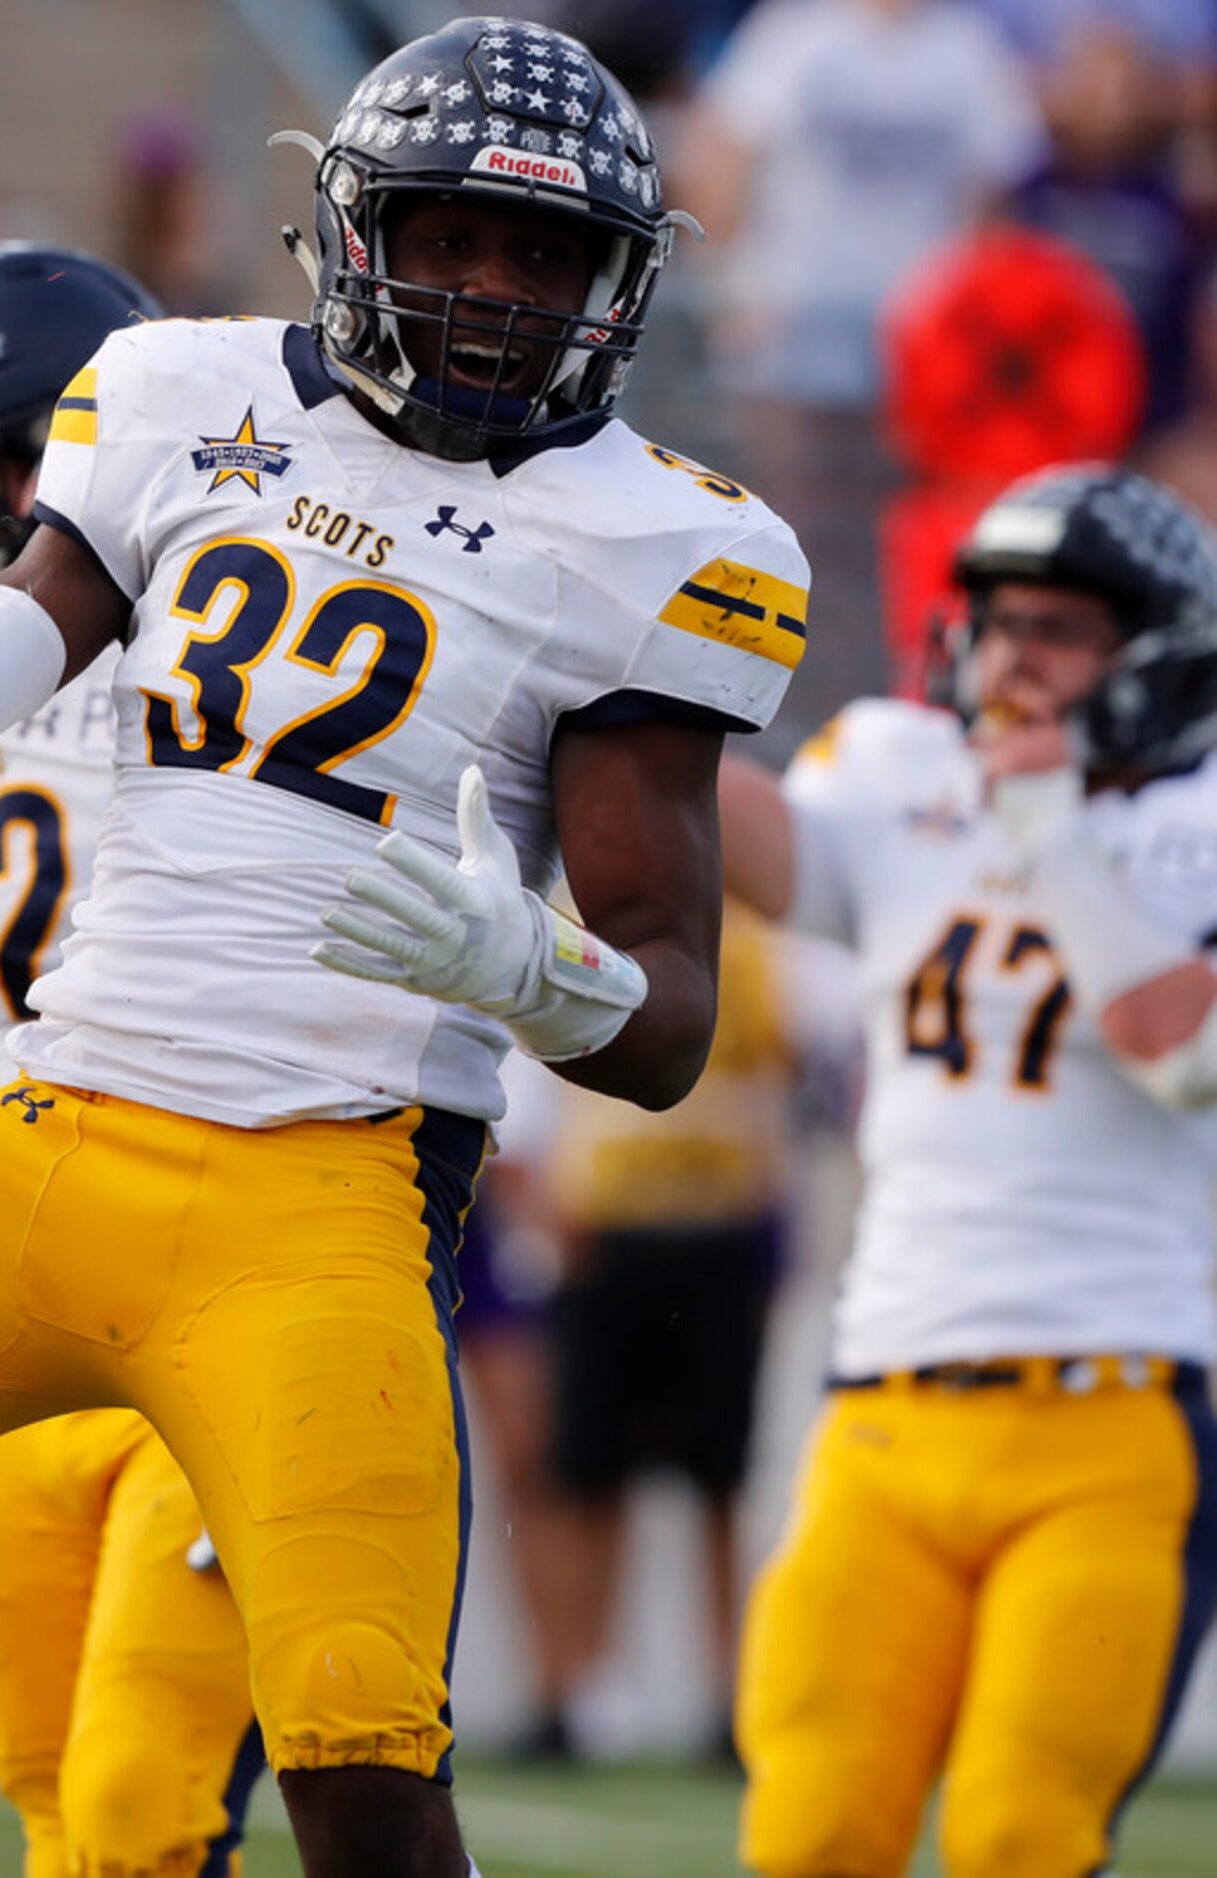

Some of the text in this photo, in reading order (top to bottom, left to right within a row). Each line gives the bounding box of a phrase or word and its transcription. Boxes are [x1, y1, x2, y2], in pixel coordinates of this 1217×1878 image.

[286, 495, 395, 567] SCOTS
[137, 535, 438, 829] 32
[904, 913, 1074, 1093] 47
